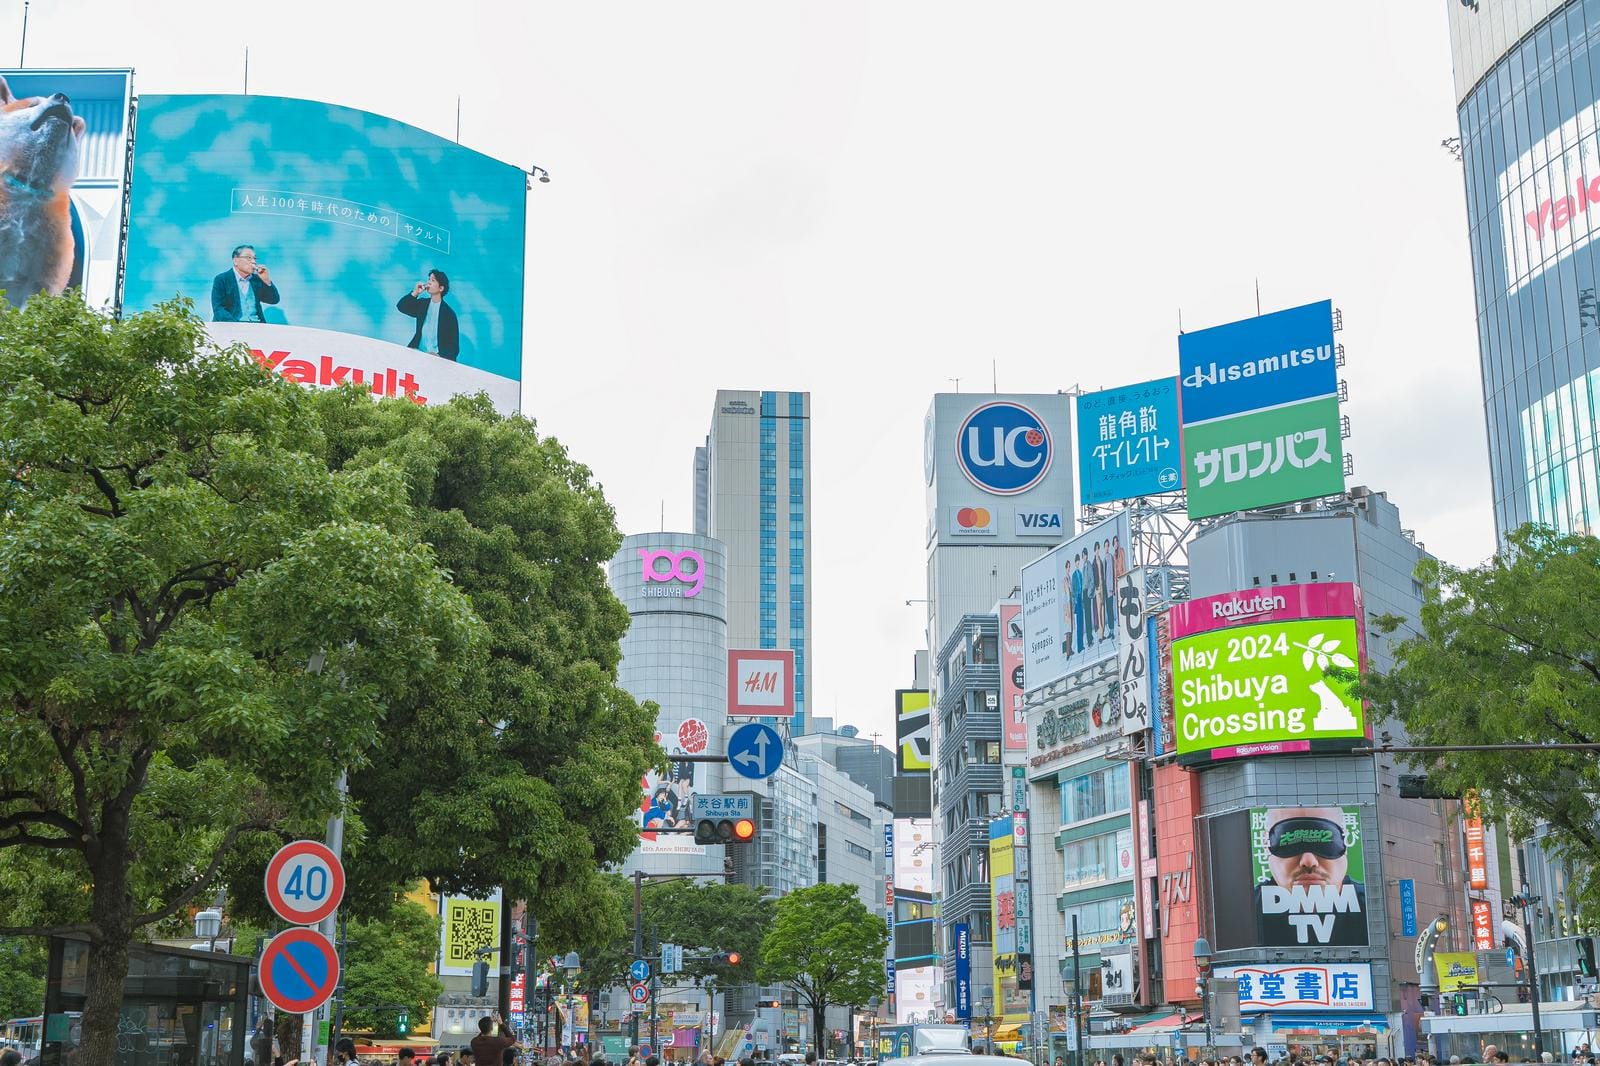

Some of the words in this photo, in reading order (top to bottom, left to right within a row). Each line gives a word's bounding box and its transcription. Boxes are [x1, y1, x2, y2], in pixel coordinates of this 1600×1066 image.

[242, 197, 390, 226] 人生100年時代のための
[404, 222, 442, 244] ヤクルト
[1183, 344, 1331, 388] Hisamitsu
[1099, 405, 1157, 441] 龍角散
[968, 425, 1042, 468] UC
[1092, 435, 1170, 471] ダイレクト
[1194, 428, 1332, 488] サロンパス
[1018, 513, 1060, 528] VISA
[636, 548, 705, 597] 109
[641, 587, 681, 597] SHIBUYA
[1212, 595, 1286, 619] Rakuten
[1119, 575, 1147, 726] もんじゃ
[1179, 646, 1218, 673] May
[1227, 632, 1290, 663] 2024
[745, 672, 777, 693] H&M
[1181, 672, 1288, 708] Shibuya
[1183, 703, 1306, 741] Crossing
[1236, 746, 1259, 754] Rakuten
[1260, 744, 1279, 752] Vision
[697, 798, 748, 809] 渋谷駅前
[1252, 812, 1272, 882] 脱出せよ
[1342, 812, 1360, 847] 再び
[1468, 827, 1485, 882] 三千里
[284, 865, 327, 901] 40
[1261, 884, 1361, 914] DMM
[1288, 914, 1336, 944] TV
[887, 970, 895, 993] LABI
[1238, 971, 1359, 1001] 盛堂書店
